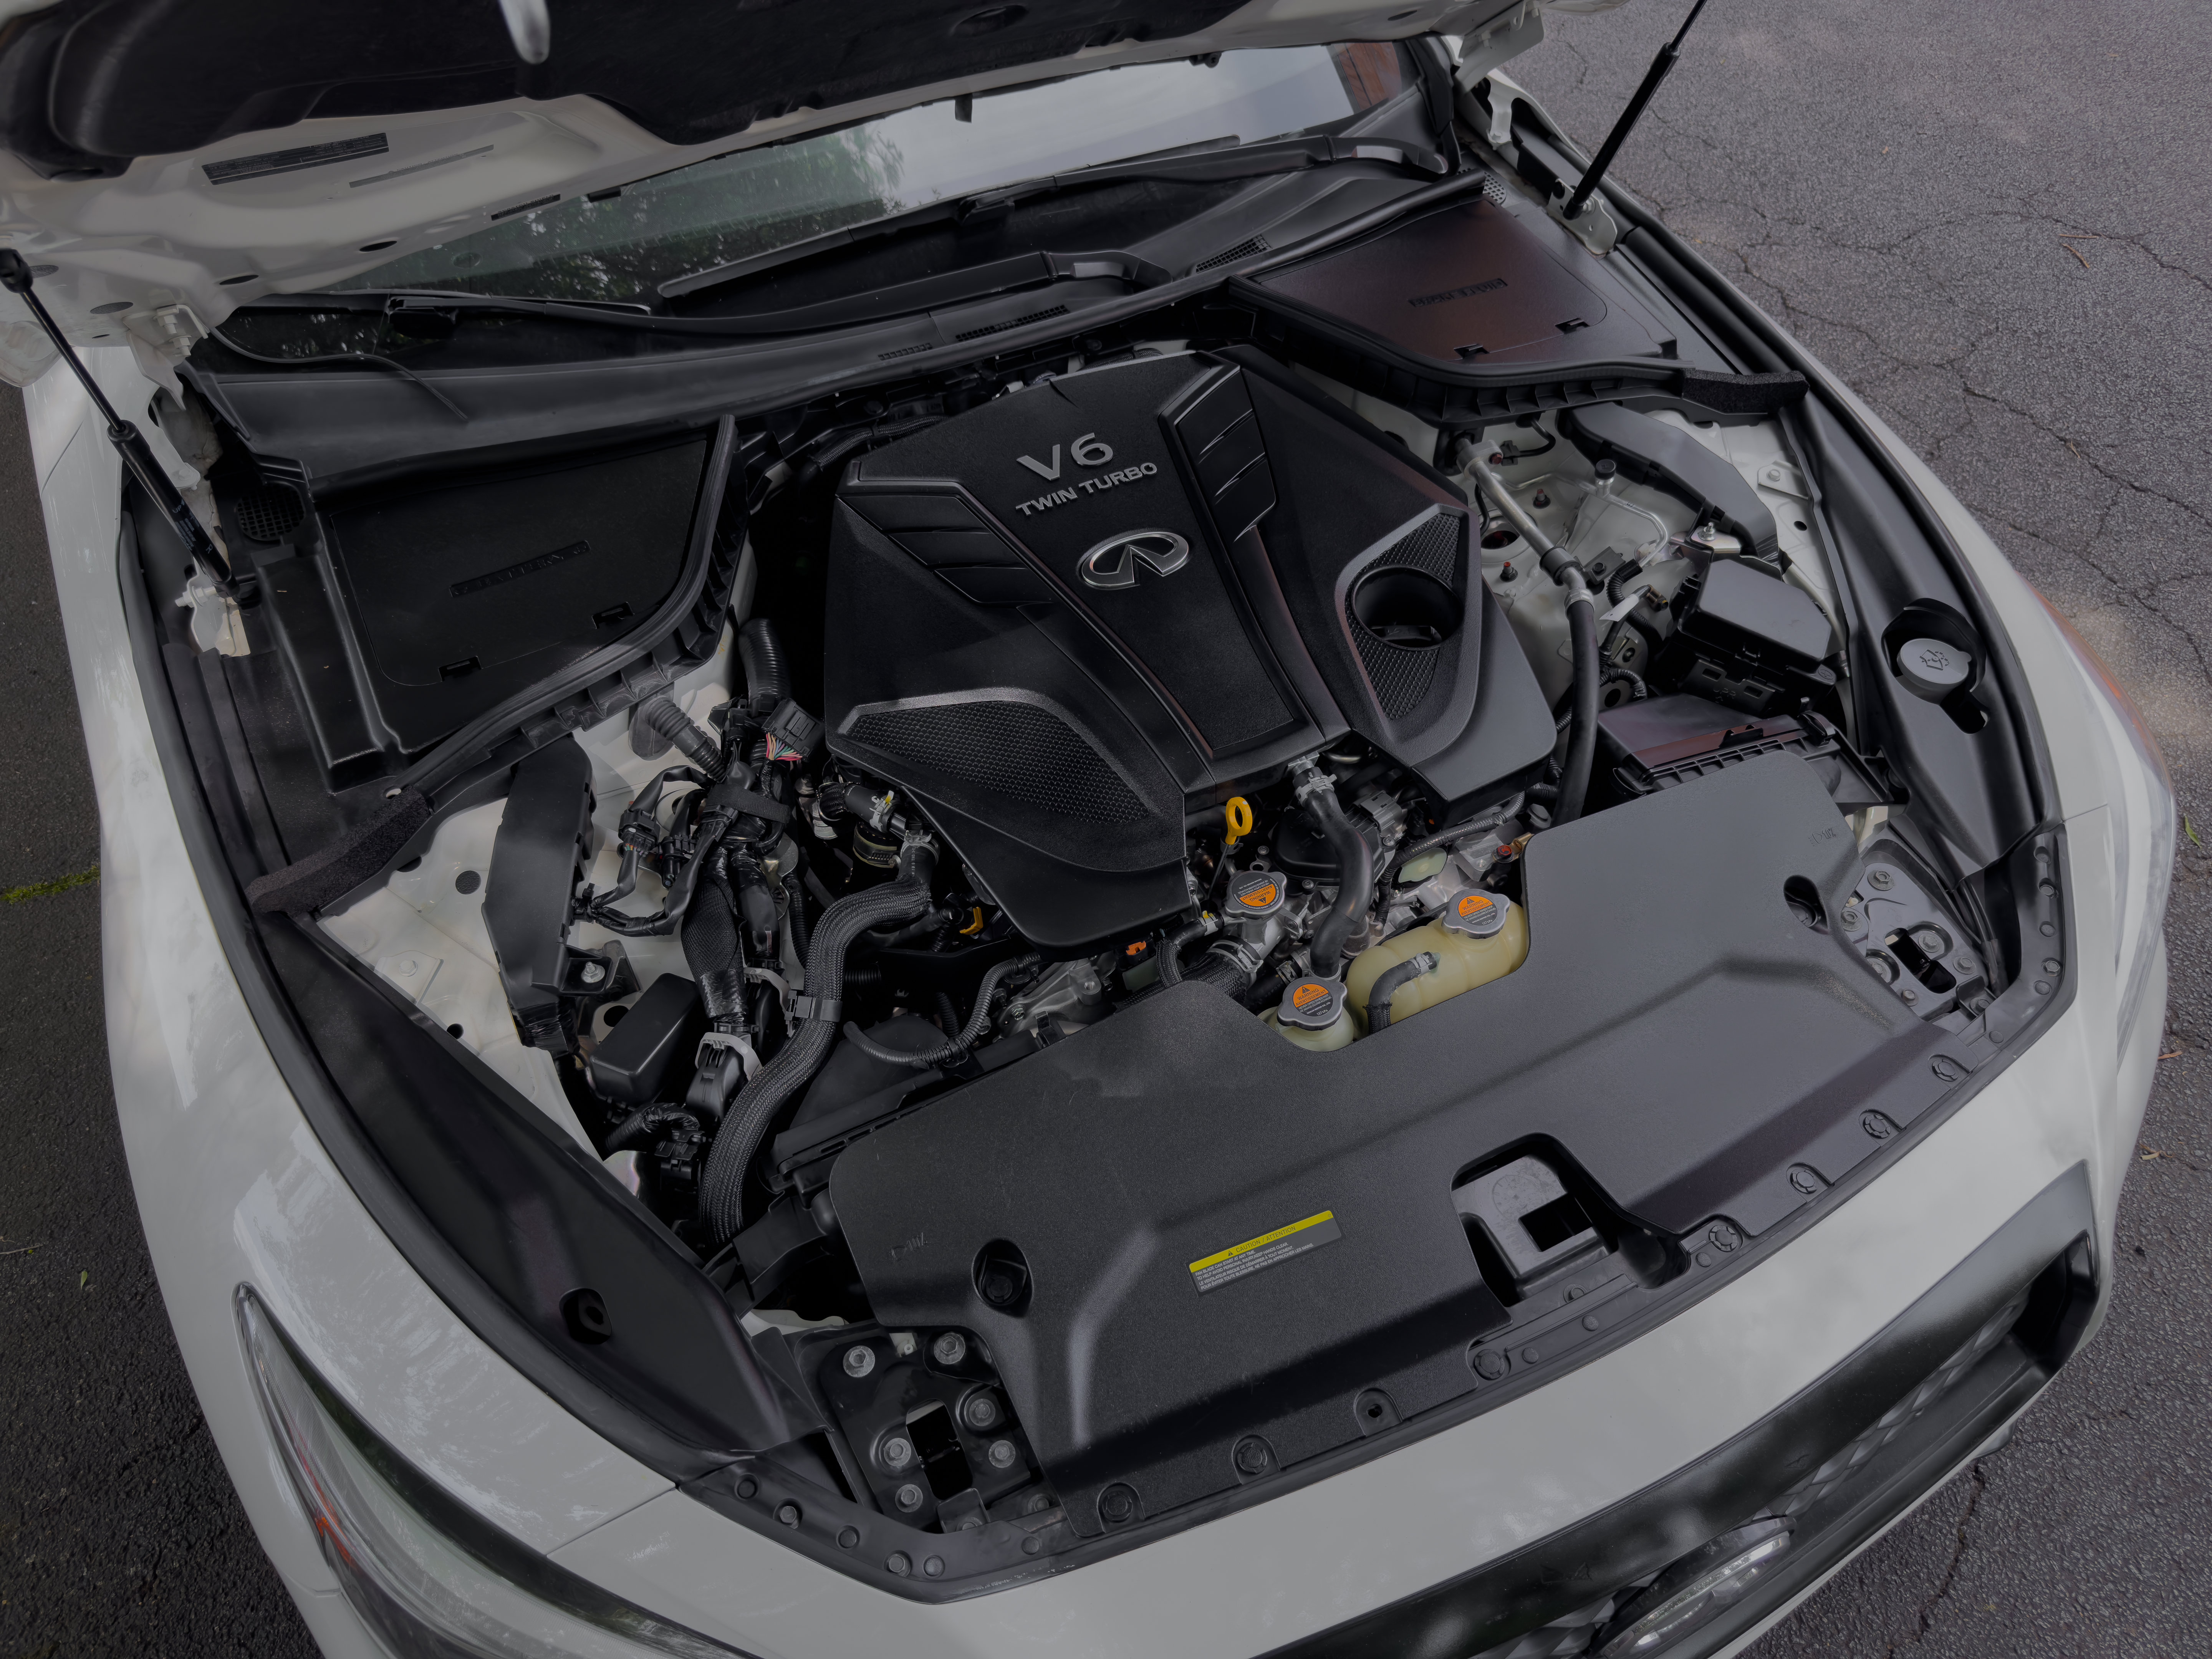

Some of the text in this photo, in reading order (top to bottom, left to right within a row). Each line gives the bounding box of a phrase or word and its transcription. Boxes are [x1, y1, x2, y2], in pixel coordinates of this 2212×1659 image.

[1016, 432, 1113, 480] V6
[1015, 462, 1157, 516] TWIN TURBO
[172, 505, 182, 513] UP
[205, 544, 213, 554] R
[1242, 886, 1272, 899] AVERTISSEMENT
[1249, 891, 1271, 901] WARNING
[1461, 901, 1490, 915] AVERTISSEMENT
[1462, 899, 1484, 910] WARNING
[1295, 990, 1326, 1005] AVERTISSEMENT
[1296, 988, 1320, 1000] WARNING
[1235, 1240, 1261, 1253] CAUTION
[1265, 1225, 1296, 1241] ATTENTION
[1203, 1272, 1227, 1283] VENTILATEUR
[1226, 1266, 1240, 1275] RISQUE
[1245, 1256, 1265, 1267] DÉMARRER
[1277, 1245, 1294, 1254] MOMENT.
[1210, 1277, 1224, 1286] ÉVITER
[1235, 1265, 1255, 1276] BLESSURE,
[1272, 1250, 1295, 1262] APPROCHER
[1301, 1242, 1314, 1250] MAINS.
[1223, 1260, 1242, 1270] PERSONAL
[1263, 1246, 1276, 1254] HANDS
